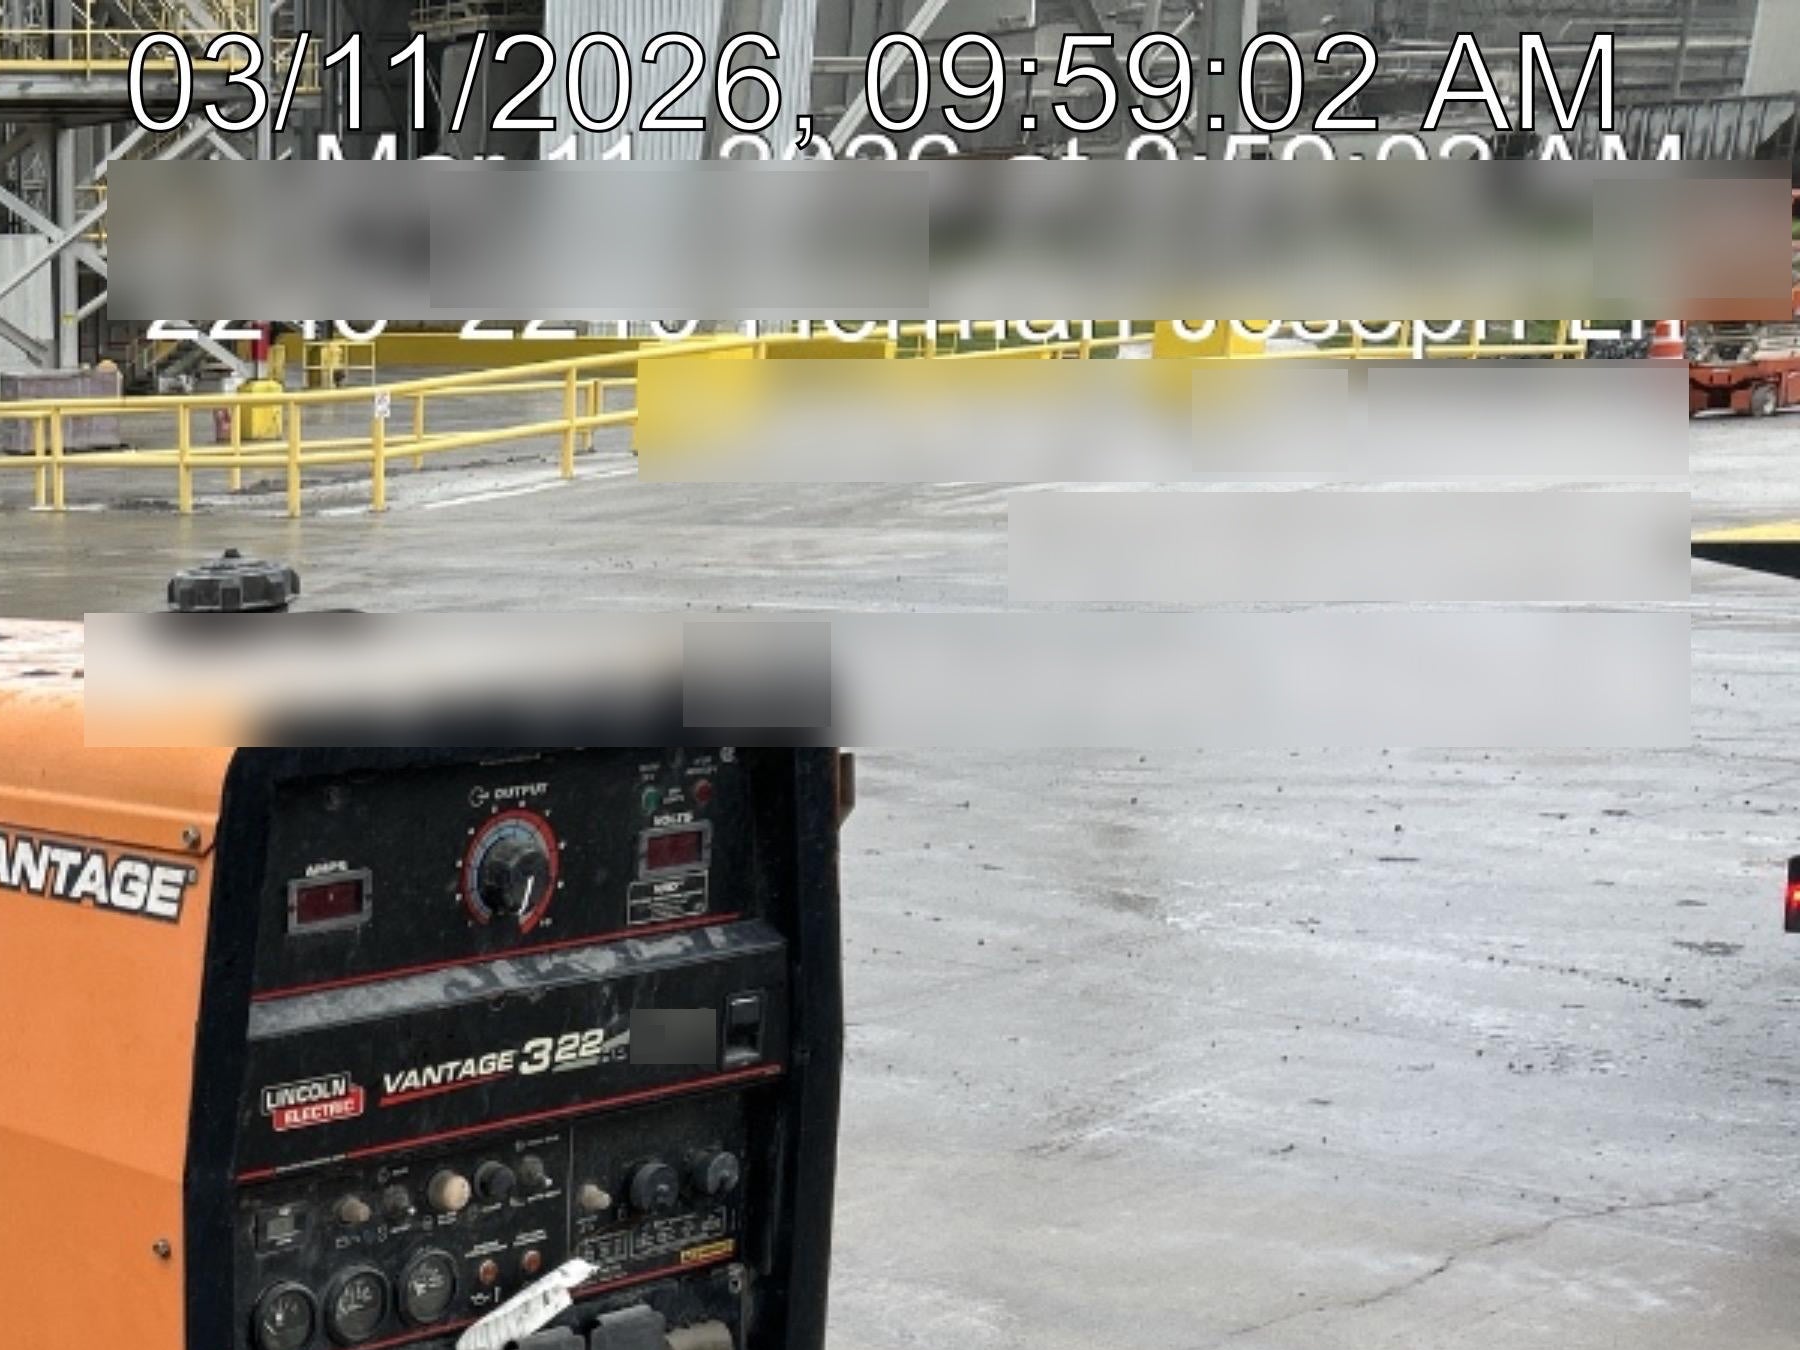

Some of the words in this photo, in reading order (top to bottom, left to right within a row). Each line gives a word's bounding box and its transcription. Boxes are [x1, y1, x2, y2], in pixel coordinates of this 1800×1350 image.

[383, 1048, 518, 1095] VANTAGE
[519, 1028, 604, 1075] 322
[266, 1077, 346, 1109] LINCOLN
[284, 1097, 355, 1123] ELECTRIC
